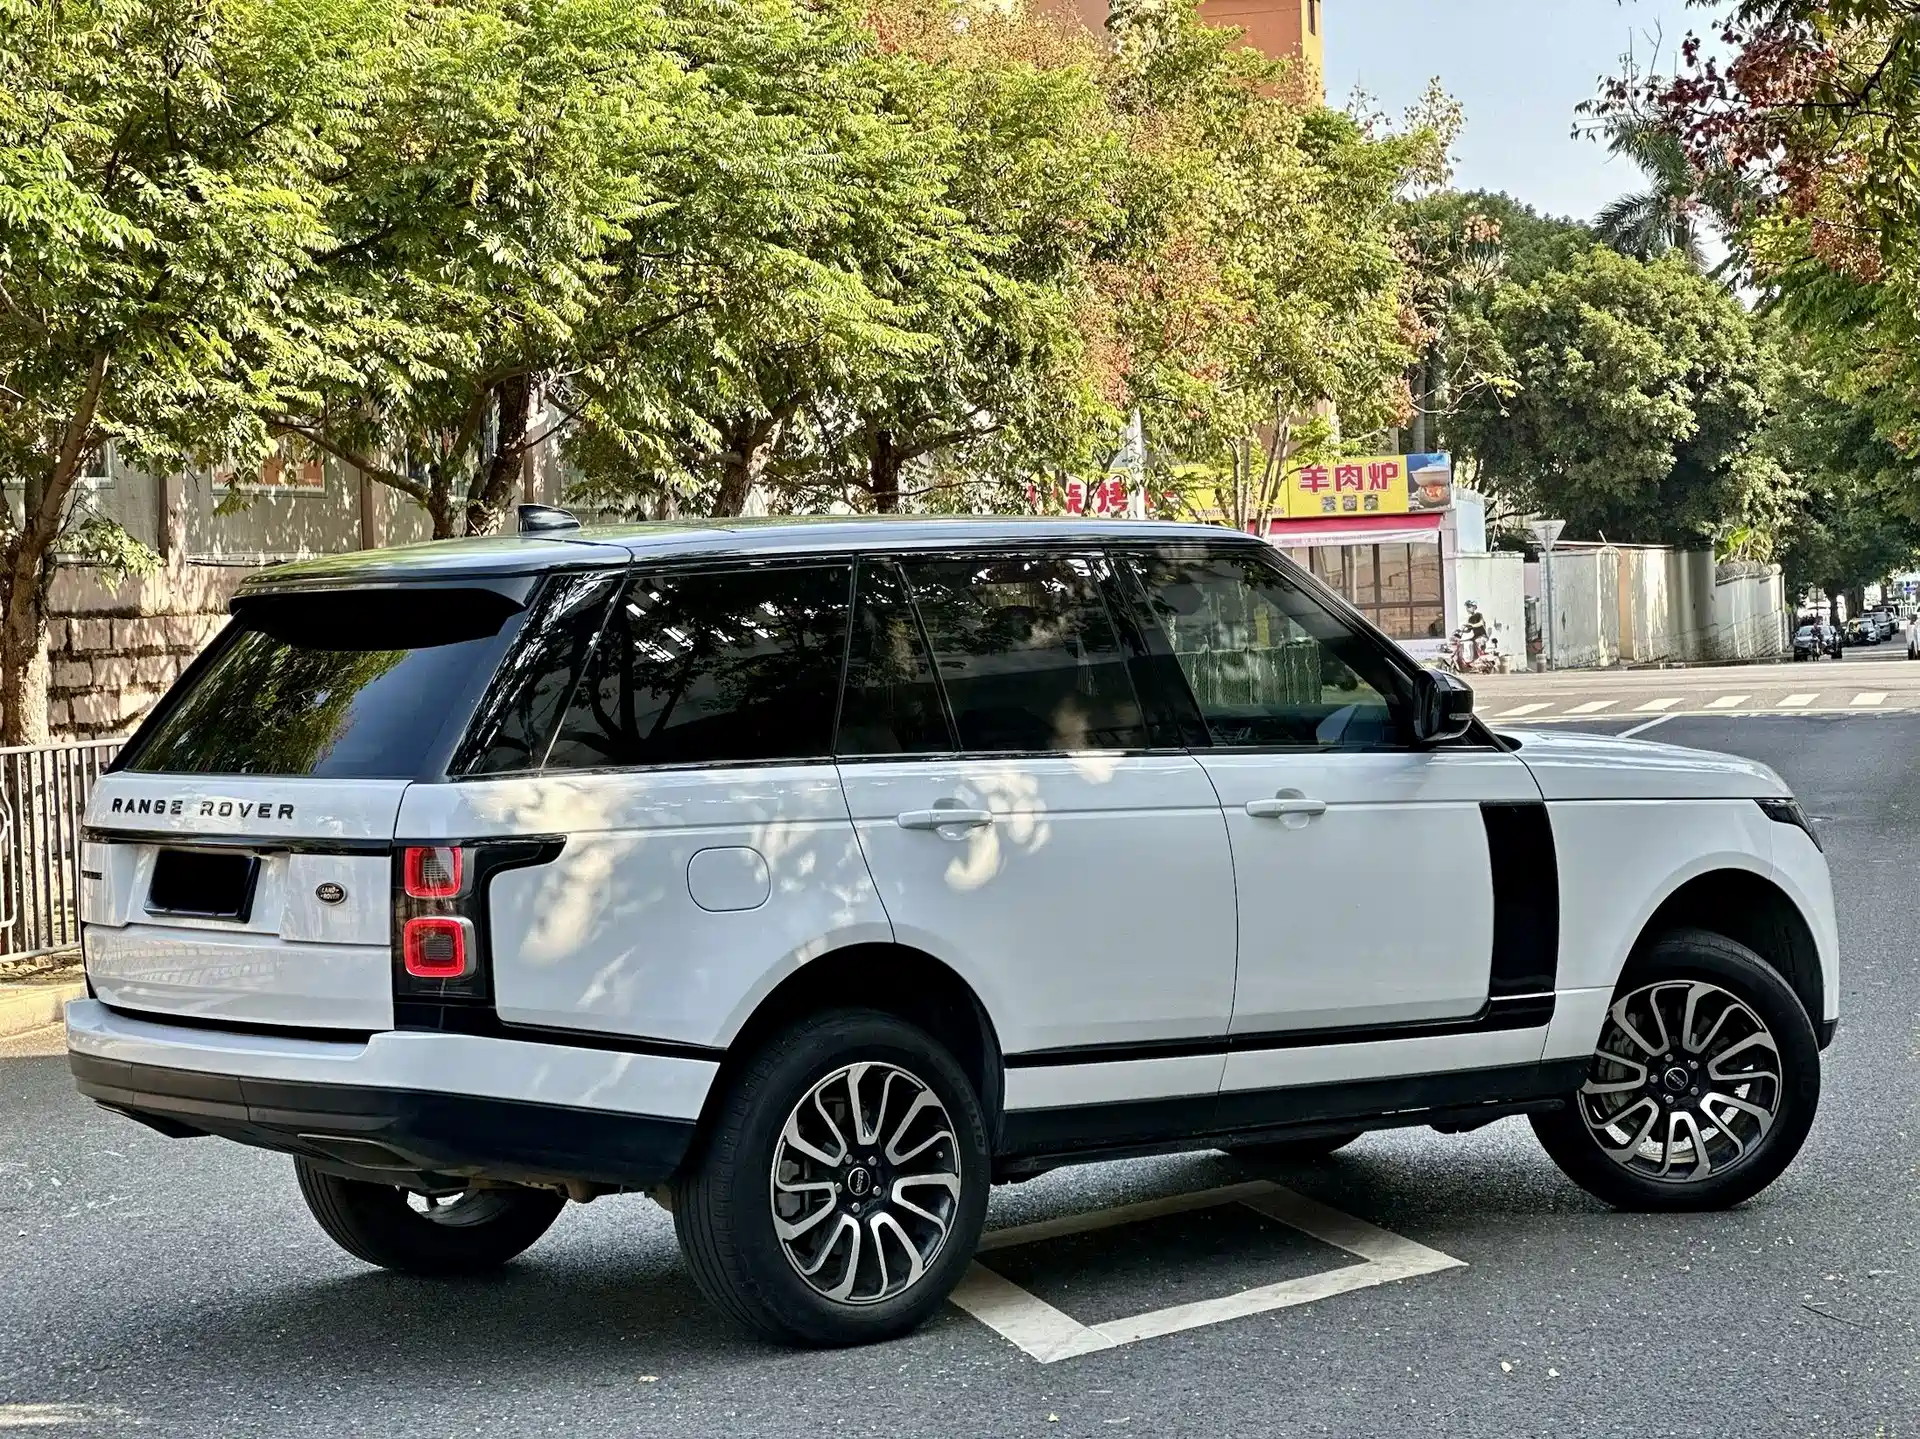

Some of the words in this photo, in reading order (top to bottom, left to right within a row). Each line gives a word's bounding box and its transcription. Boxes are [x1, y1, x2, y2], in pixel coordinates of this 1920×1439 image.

[1299, 462, 1399, 493] 羊肉炉
[112, 798, 184, 815] RANGE
[199, 800, 295, 820] ROVER
